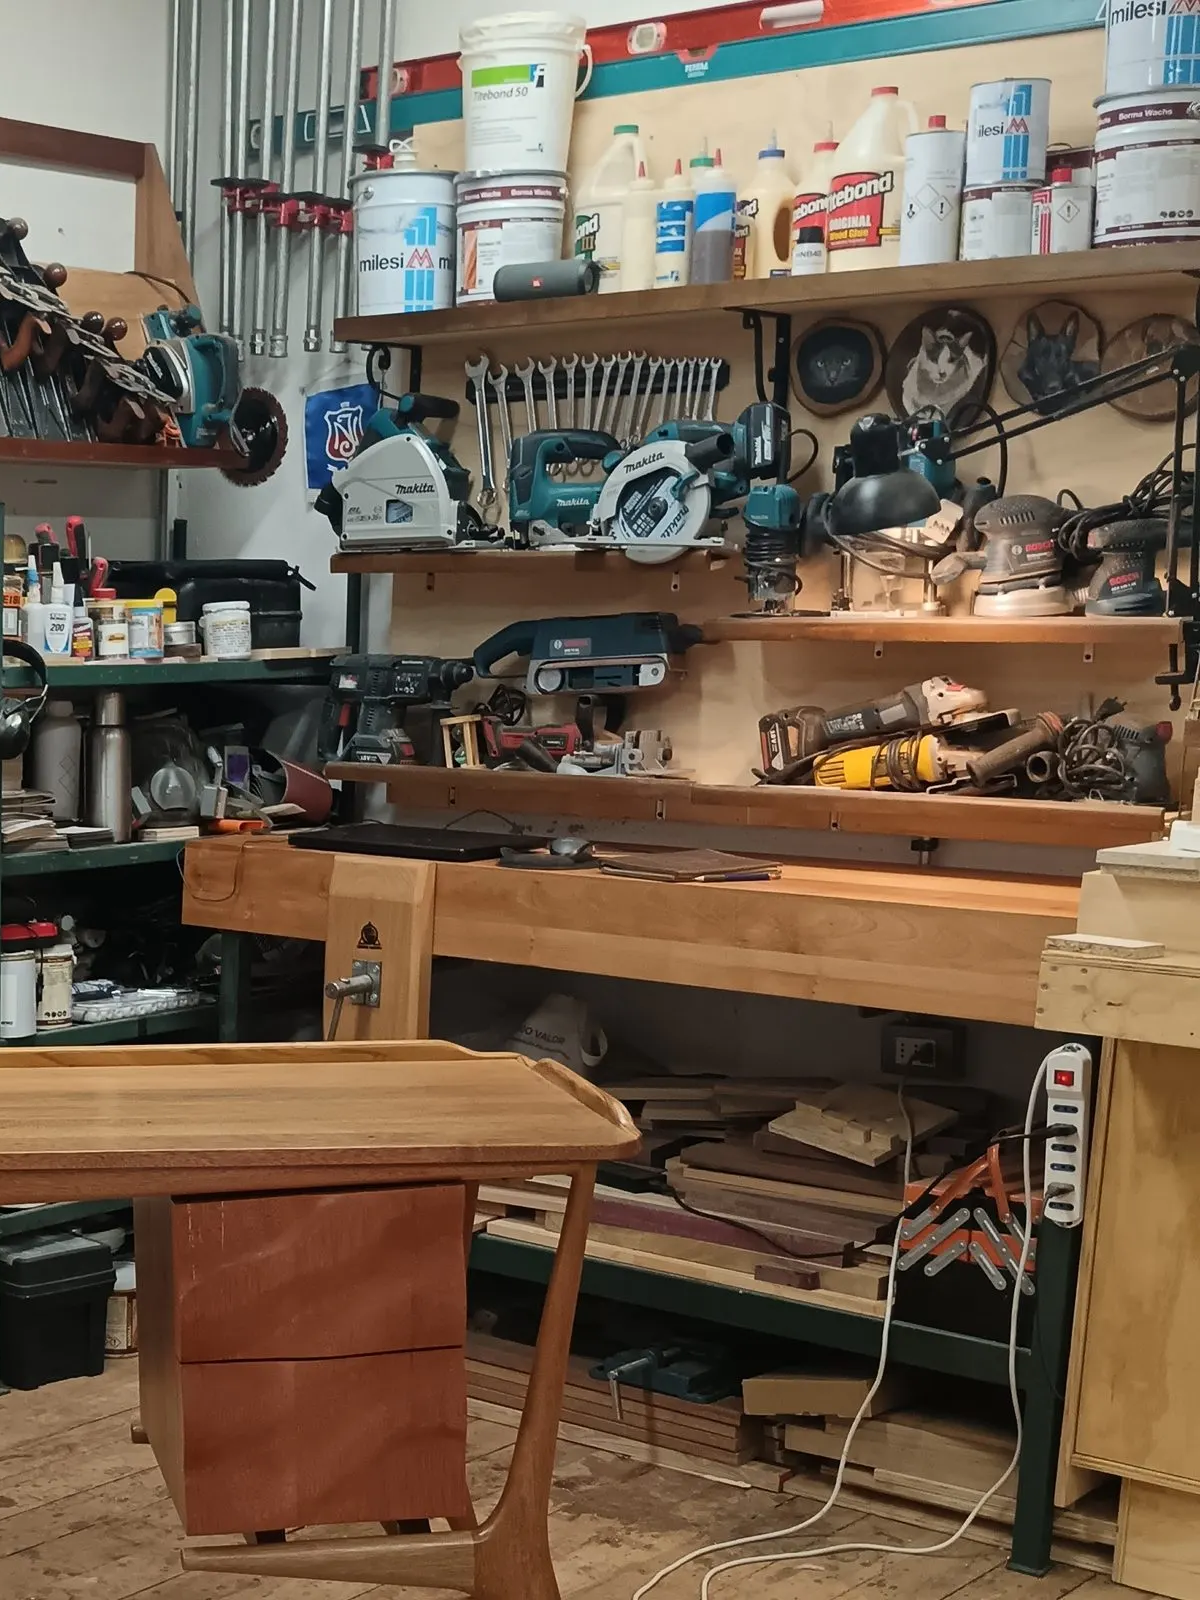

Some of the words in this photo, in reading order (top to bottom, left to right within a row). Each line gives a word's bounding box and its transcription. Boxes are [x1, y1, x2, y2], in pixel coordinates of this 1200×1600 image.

[473, 88, 514, 101] Titebond
[515, 87, 529, 98] 50
[978, 121, 1004, 137] ilesi
[359, 253, 404, 273] milesi
[49, 623, 65, 632] 200
